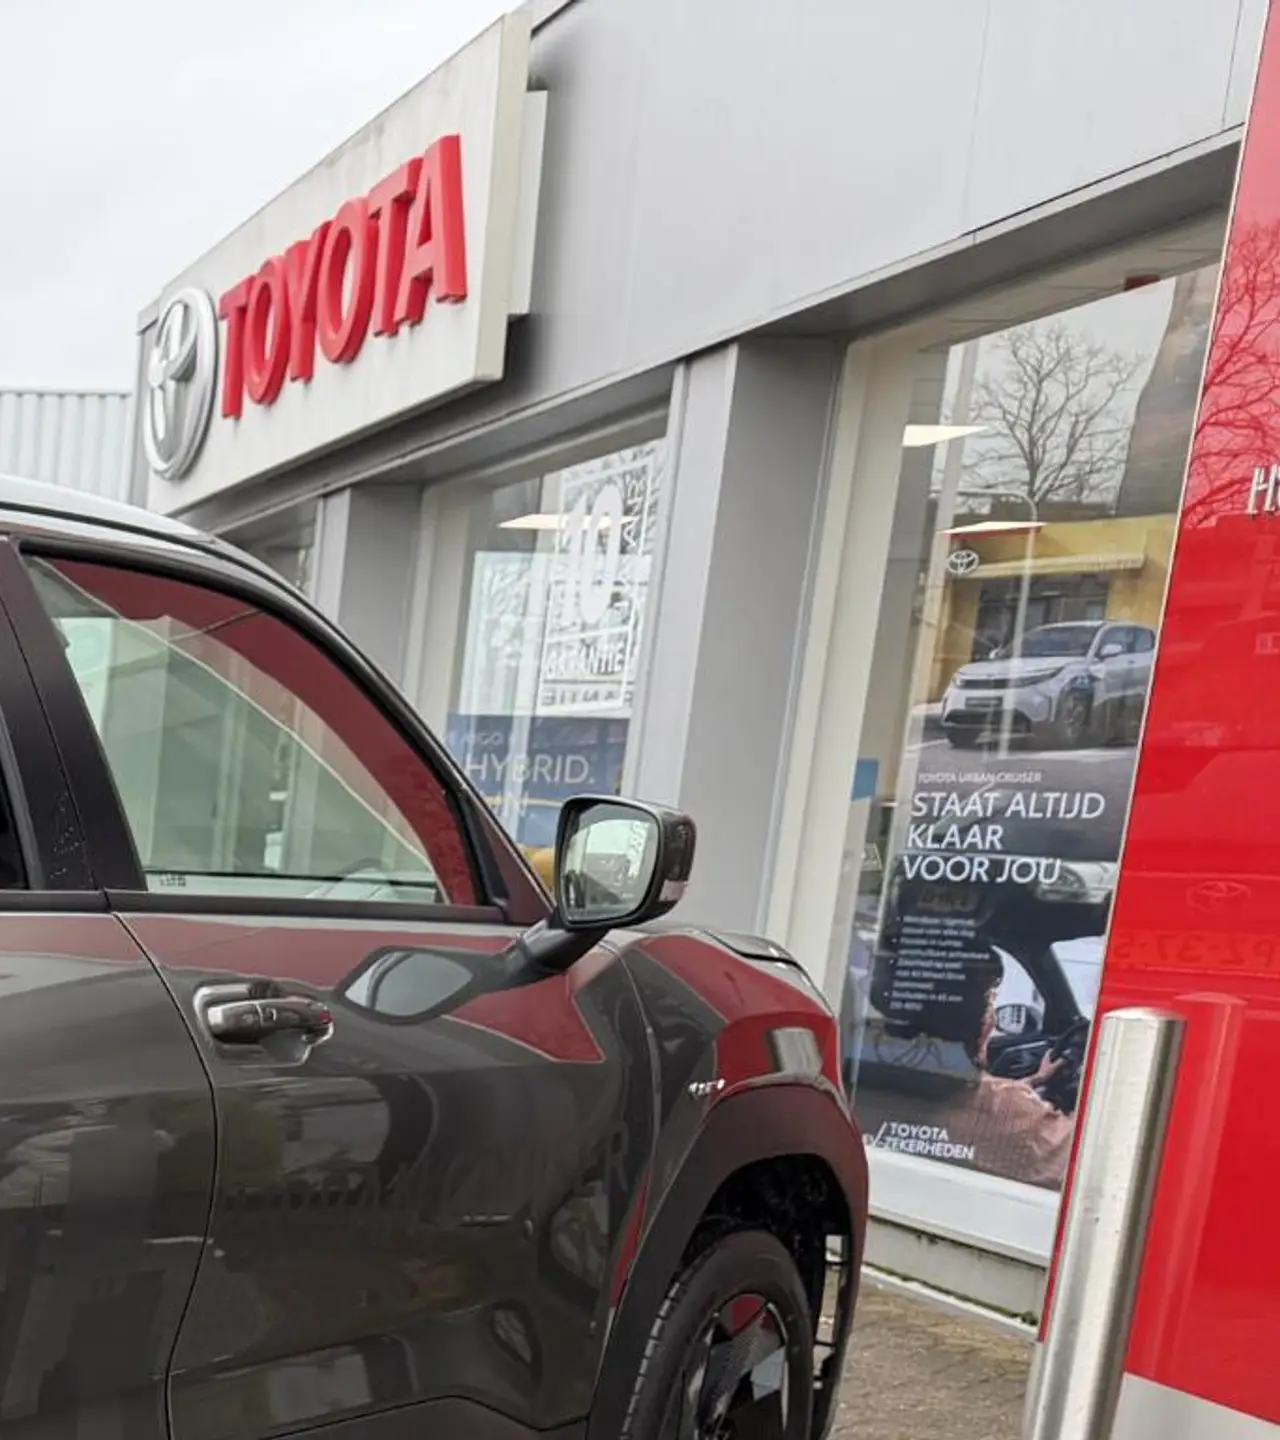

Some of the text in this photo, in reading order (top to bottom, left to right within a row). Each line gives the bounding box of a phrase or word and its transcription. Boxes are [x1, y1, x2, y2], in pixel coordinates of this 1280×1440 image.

[219, 133, 467, 419] TOYOTA
[464, 752, 597, 786] HYBRID.
[918, 771, 957, 784] TOYOTA
[911, 791, 1105, 819] STAAT ALTIJD
[906, 823, 1004, 851] KLAAR
[903, 854, 1062, 885] VOOR JOU
[889, 1121, 949, 1141] TOYOTA
